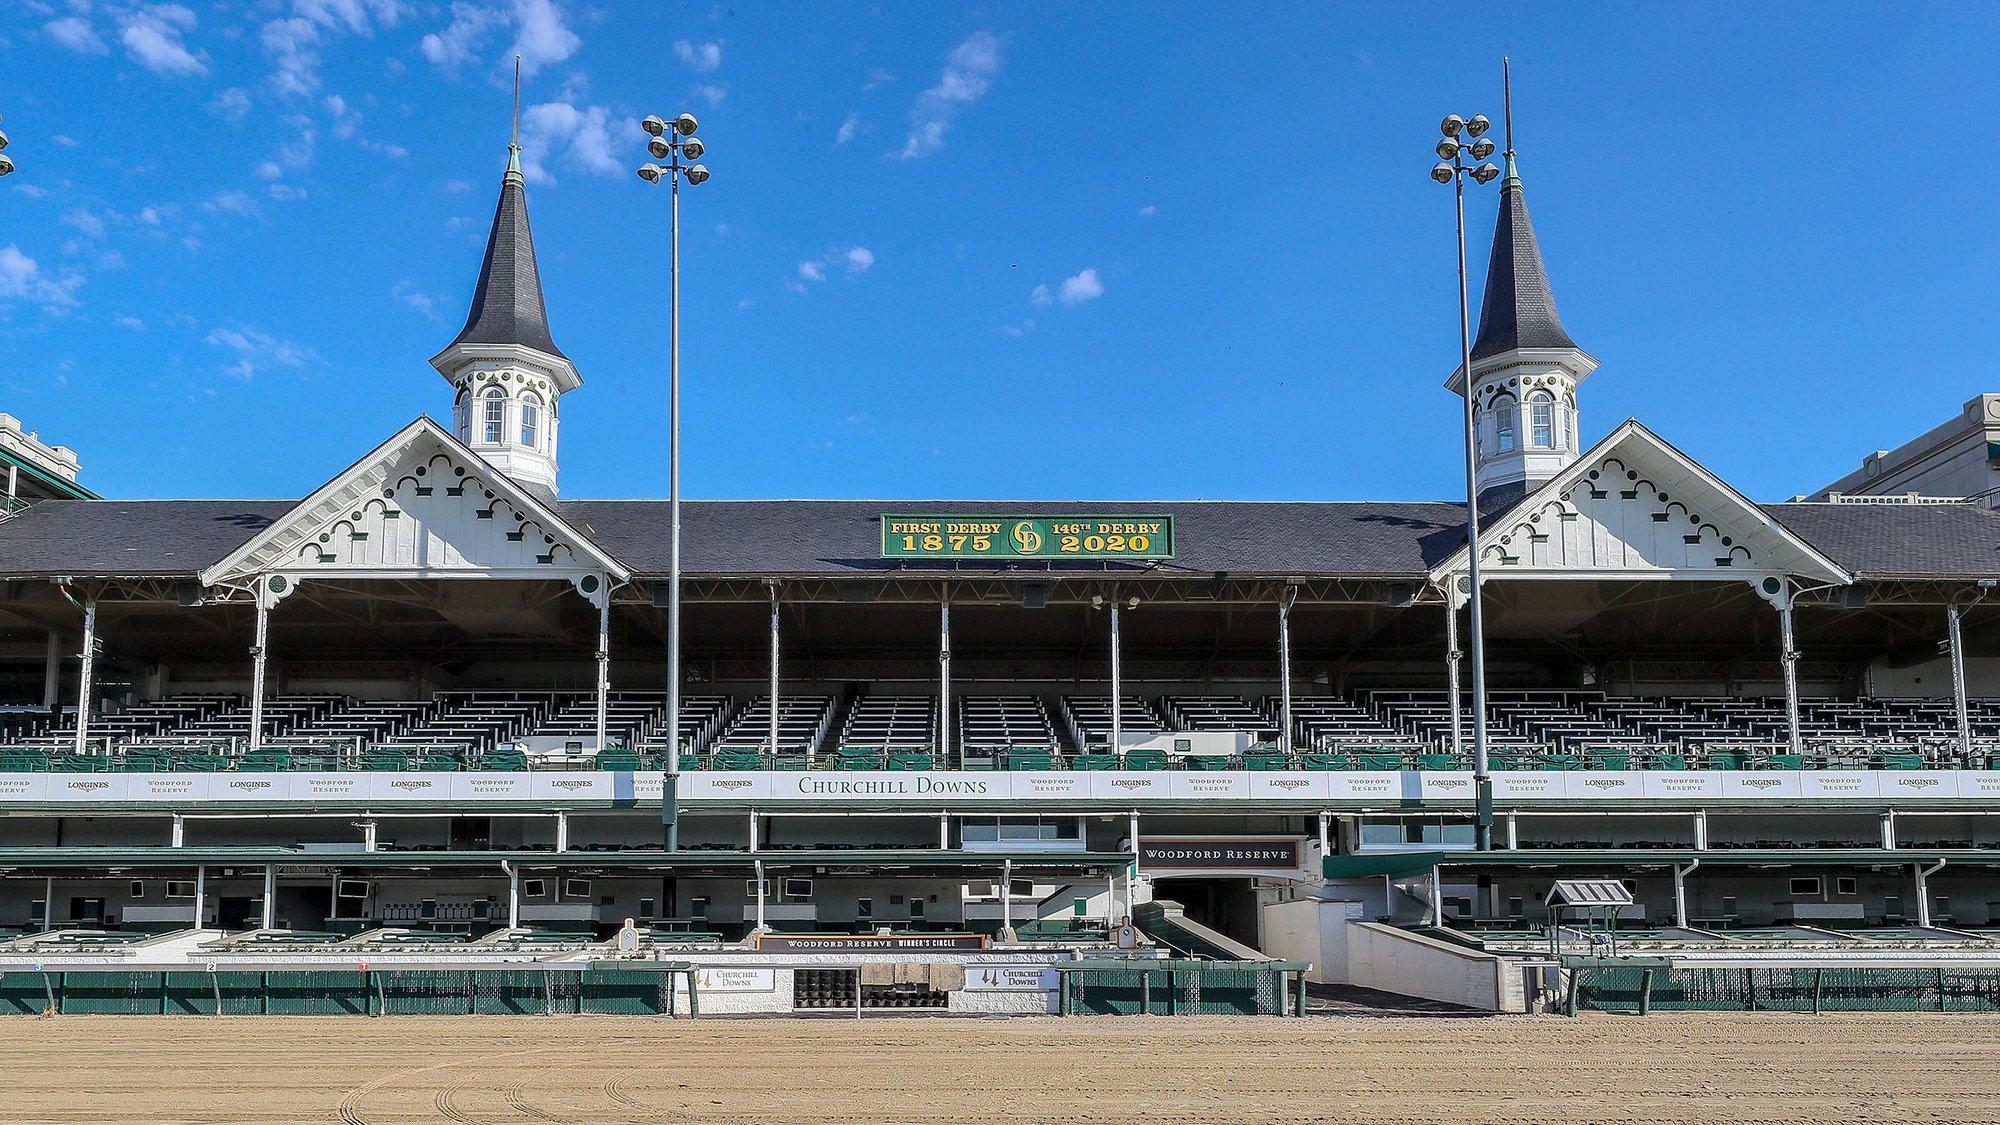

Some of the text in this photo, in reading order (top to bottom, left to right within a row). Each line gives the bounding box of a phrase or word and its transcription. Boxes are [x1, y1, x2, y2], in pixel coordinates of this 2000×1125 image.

[890, 523, 1001, 534] FIRST DERBY
[1098, 523, 1161, 534] DERBY
[902, 535, 992, 552] 1875
[1060, 535, 1150, 552] 2020
[798, 776, 987, 794] CHURCHILL DOWNS
[1145, 849, 1288, 859] WOODFORD RESERVE
[787, 940, 844, 948] WOODFORD
[847, 940, 892, 948] RESERVE
[932, 939, 956, 947] CIRCLE
[208, 963, 215, 971] 2
[716, 970, 759, 978] CHURCHILL
[1002, 969, 1045, 978] CHURCHILL
[722, 978, 751, 987] DOWNS
[1008, 978, 1036, 986] DOWNS
